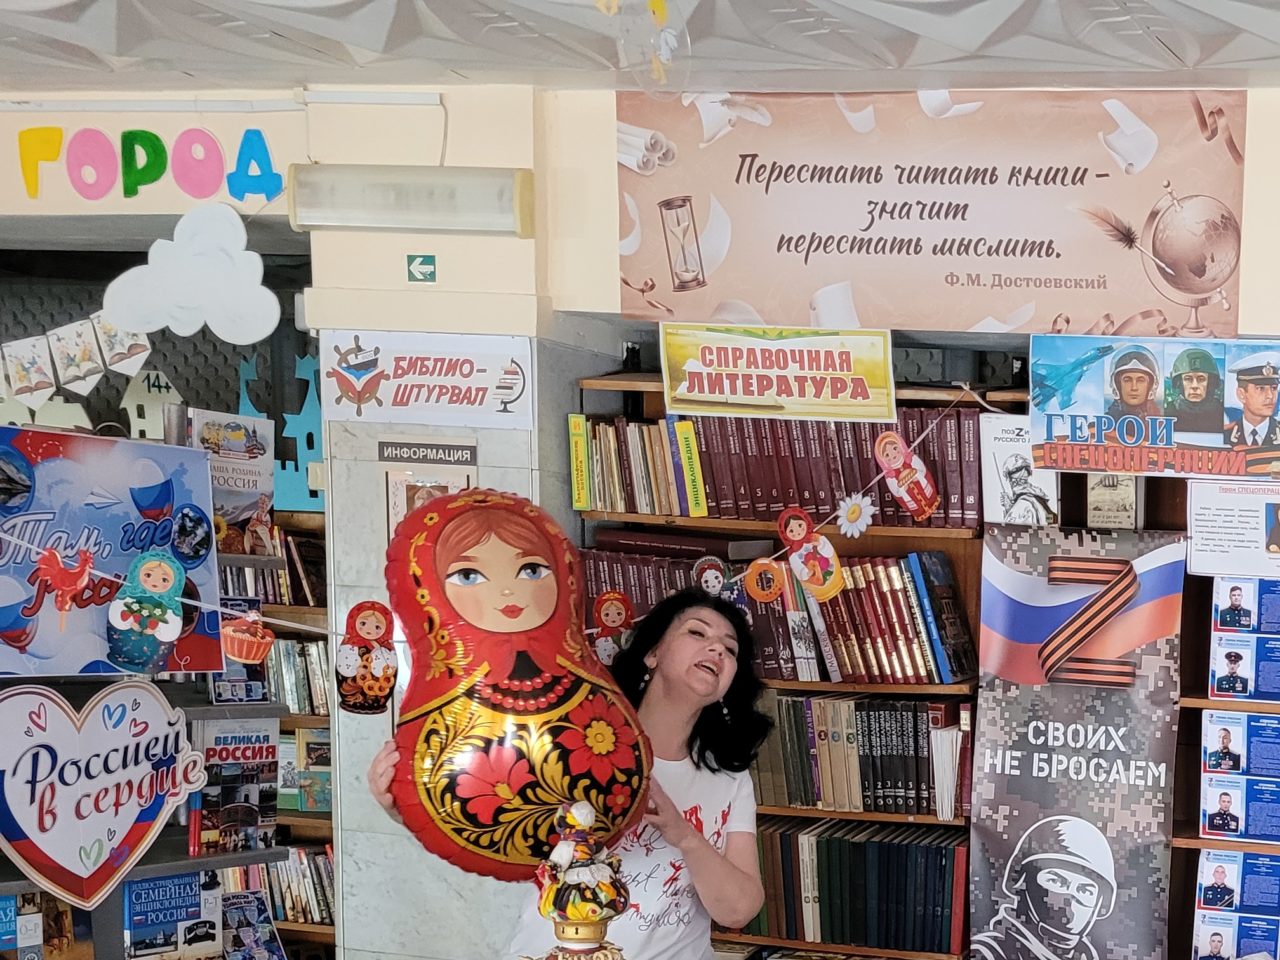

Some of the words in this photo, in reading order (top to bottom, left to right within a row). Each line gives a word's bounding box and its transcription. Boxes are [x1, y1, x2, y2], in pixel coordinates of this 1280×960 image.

[17, 126, 284, 202] ГОРОД
[735, 154, 884, 194] Перестать
[895, 163, 1000, 191] читать
[1007, 163, 1089, 191] книги
[866, 200, 969, 232] значит
[776, 234, 924, 264] перестать
[931, 236, 1063, 260] мыслить.
[944, 271, 988, 289] Ф.М.
[990, 270, 1108, 291] Достоевский
[391, 355, 488, 382] БИБЛИО-
[700, 342, 854, 374] СПРАВОЧНАЯ
[141, 370, 174, 396] 14+
[391, 382, 489, 408] ШТУРВАЛ
[685, 368, 871, 402] ЛИТЕРАТУРА
[1042, 411, 1178, 448] ГЕРОИ
[382, 445, 472, 464] ИНФОРМАЦИЯ
[1042, 443, 1249, 476] СПЕЦОПЕРАЦИИ
[211, 475, 258, 490] РОССИЯ
[119, 518, 175, 553] где
[214, 734, 271, 747] ВЕЛИКАЯ
[1027, 720, 1127, 752] СВОИХ
[11, 720, 184, 806] Россией
[205, 744, 277, 763] РОССИЯ
[983, 748, 1022, 776] НЕ
[1032, 752, 1168, 789] БРОСАЕМ
[37, 781, 57, 834] в
[74, 758, 200, 820] сердце
[132, 881, 200, 904] СЕМЕЙНАЯ
[132, 896, 200, 913] ЭНЦИКЛОПЕДИЯ
[147, 907, 187, 925] РОССИЯ
